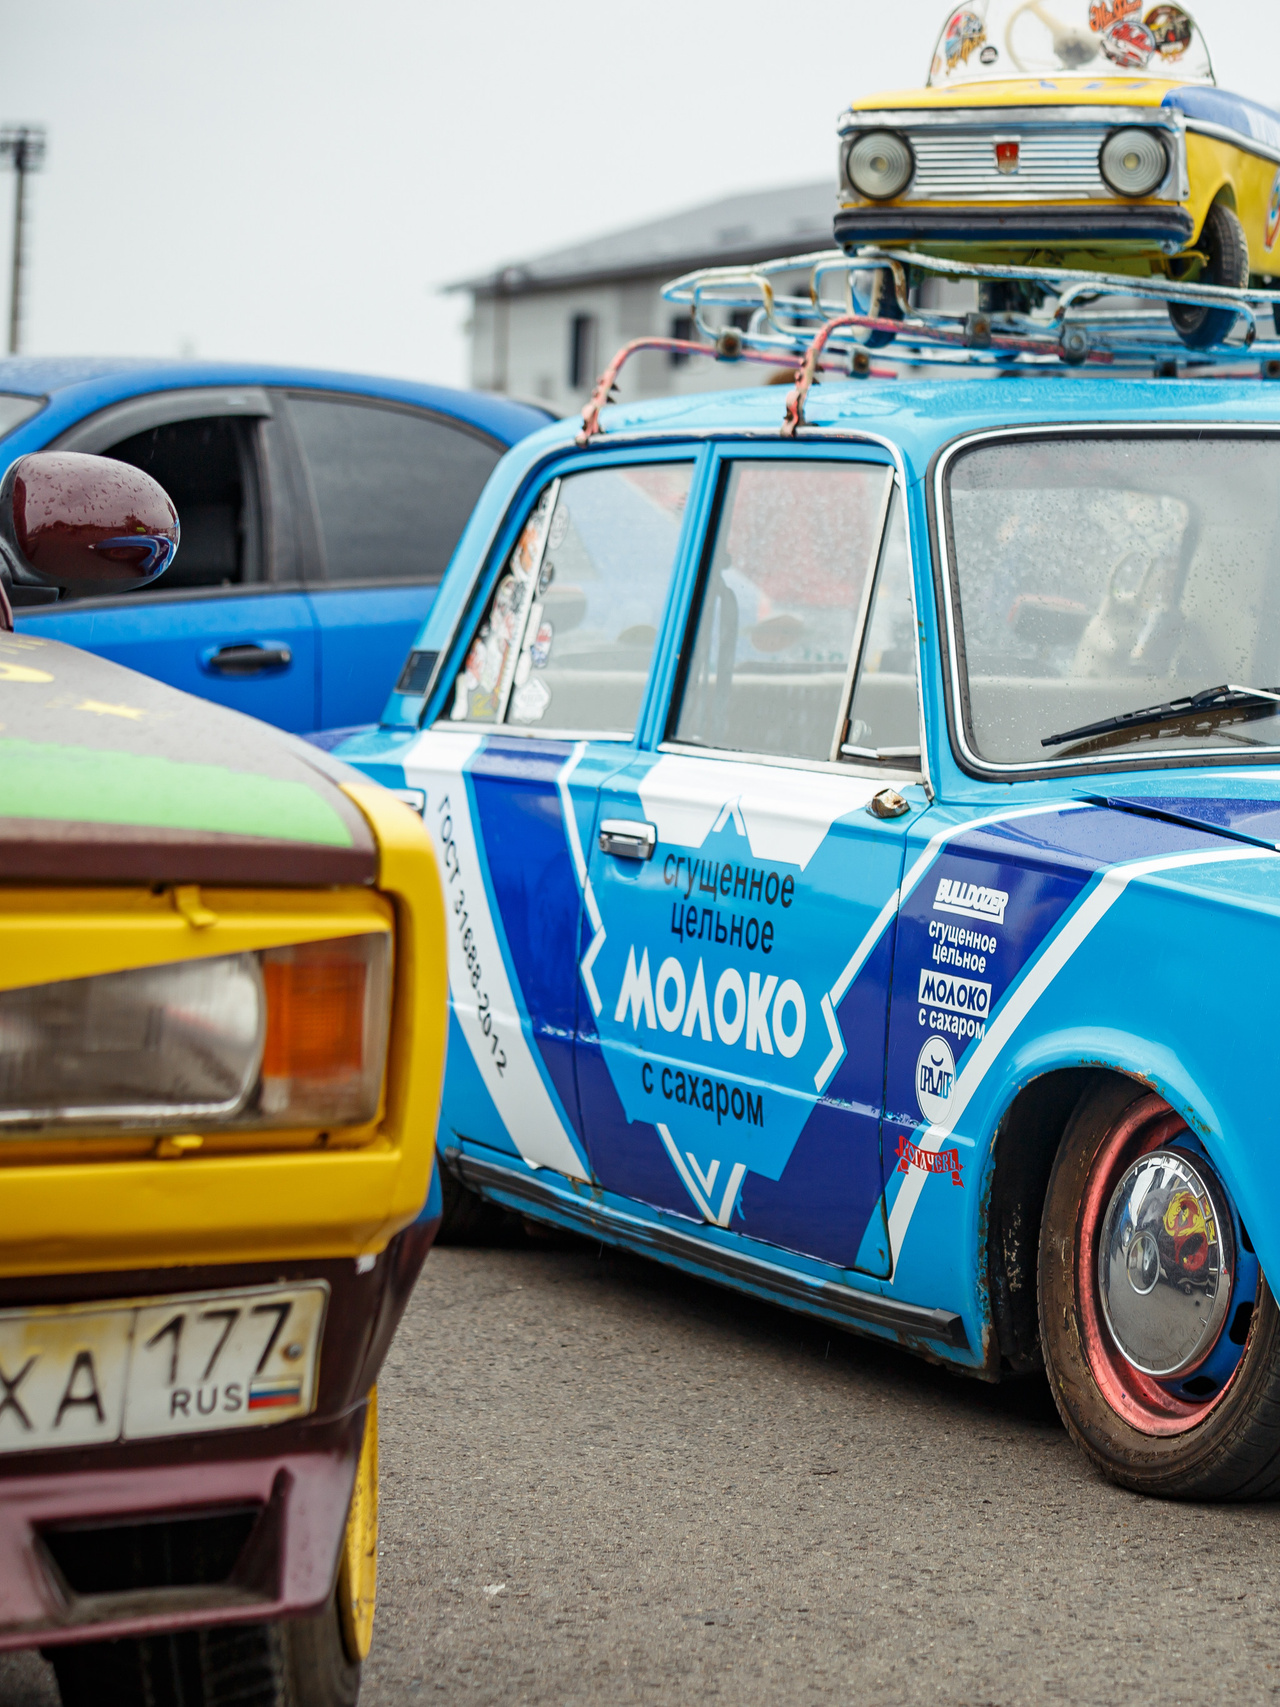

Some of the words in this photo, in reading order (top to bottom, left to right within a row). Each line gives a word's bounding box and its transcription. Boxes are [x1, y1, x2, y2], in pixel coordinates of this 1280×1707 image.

[663, 853, 796, 908] сгущенное
[438, 794, 461, 884] ГОСТ
[454, 889, 507, 1079] 31688-2012
[671, 902, 775, 954] цельное
[928, 920, 997, 954] сгущенное
[932, 943, 986, 973] цельное
[614, 943, 807, 1058] МОЛОКО
[921, 974, 988, 1012] МОЛОКО
[918, 1008, 927, 1026] с
[929, 1011, 986, 1040] сахаром
[642, 1062, 654, 1094] с
[661, 1067, 764, 1128] сахаром
[146, 1302, 292, 1385] 177
[169, 1384, 243, 1418] RUS
